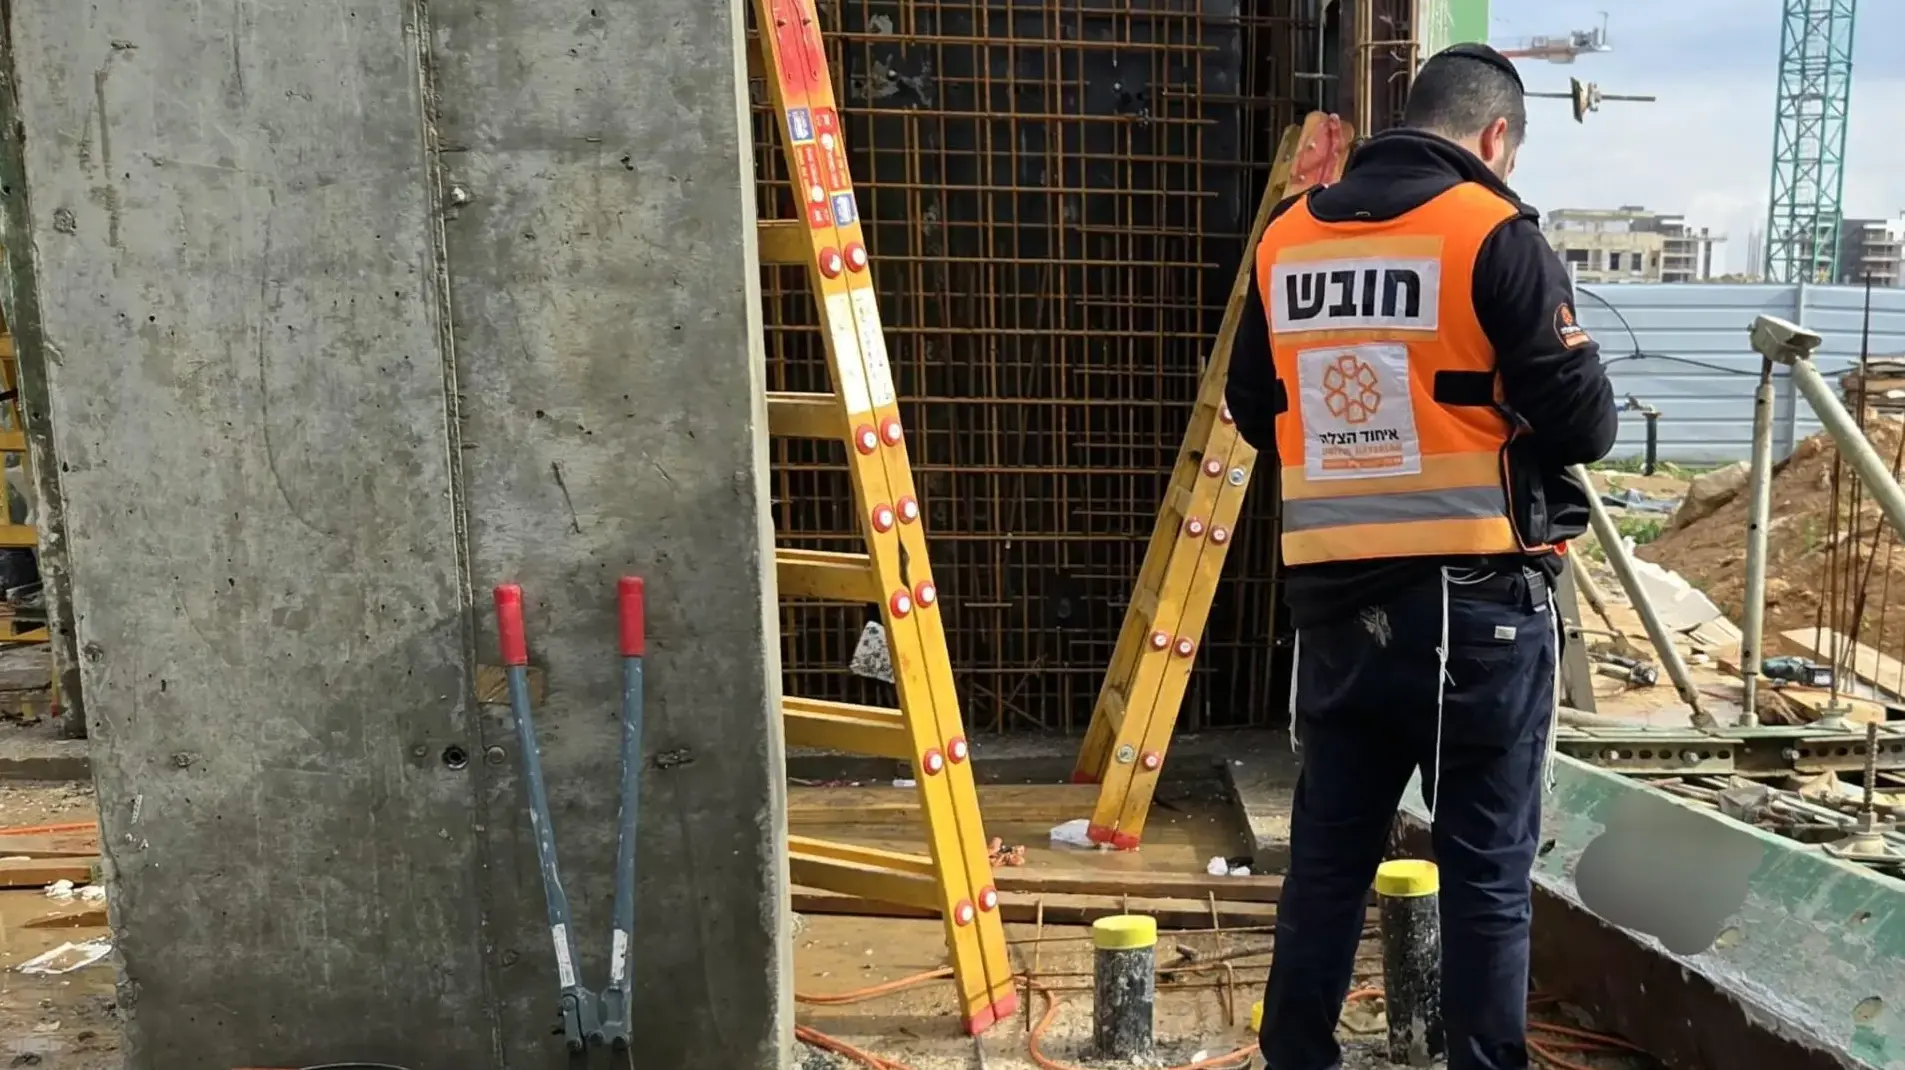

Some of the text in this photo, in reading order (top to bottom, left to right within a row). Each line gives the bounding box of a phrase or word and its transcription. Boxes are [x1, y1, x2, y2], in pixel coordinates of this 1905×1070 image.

[1286, 269, 1421, 321] חובש
[1319, 428, 1400, 445] איחוד הצלה
